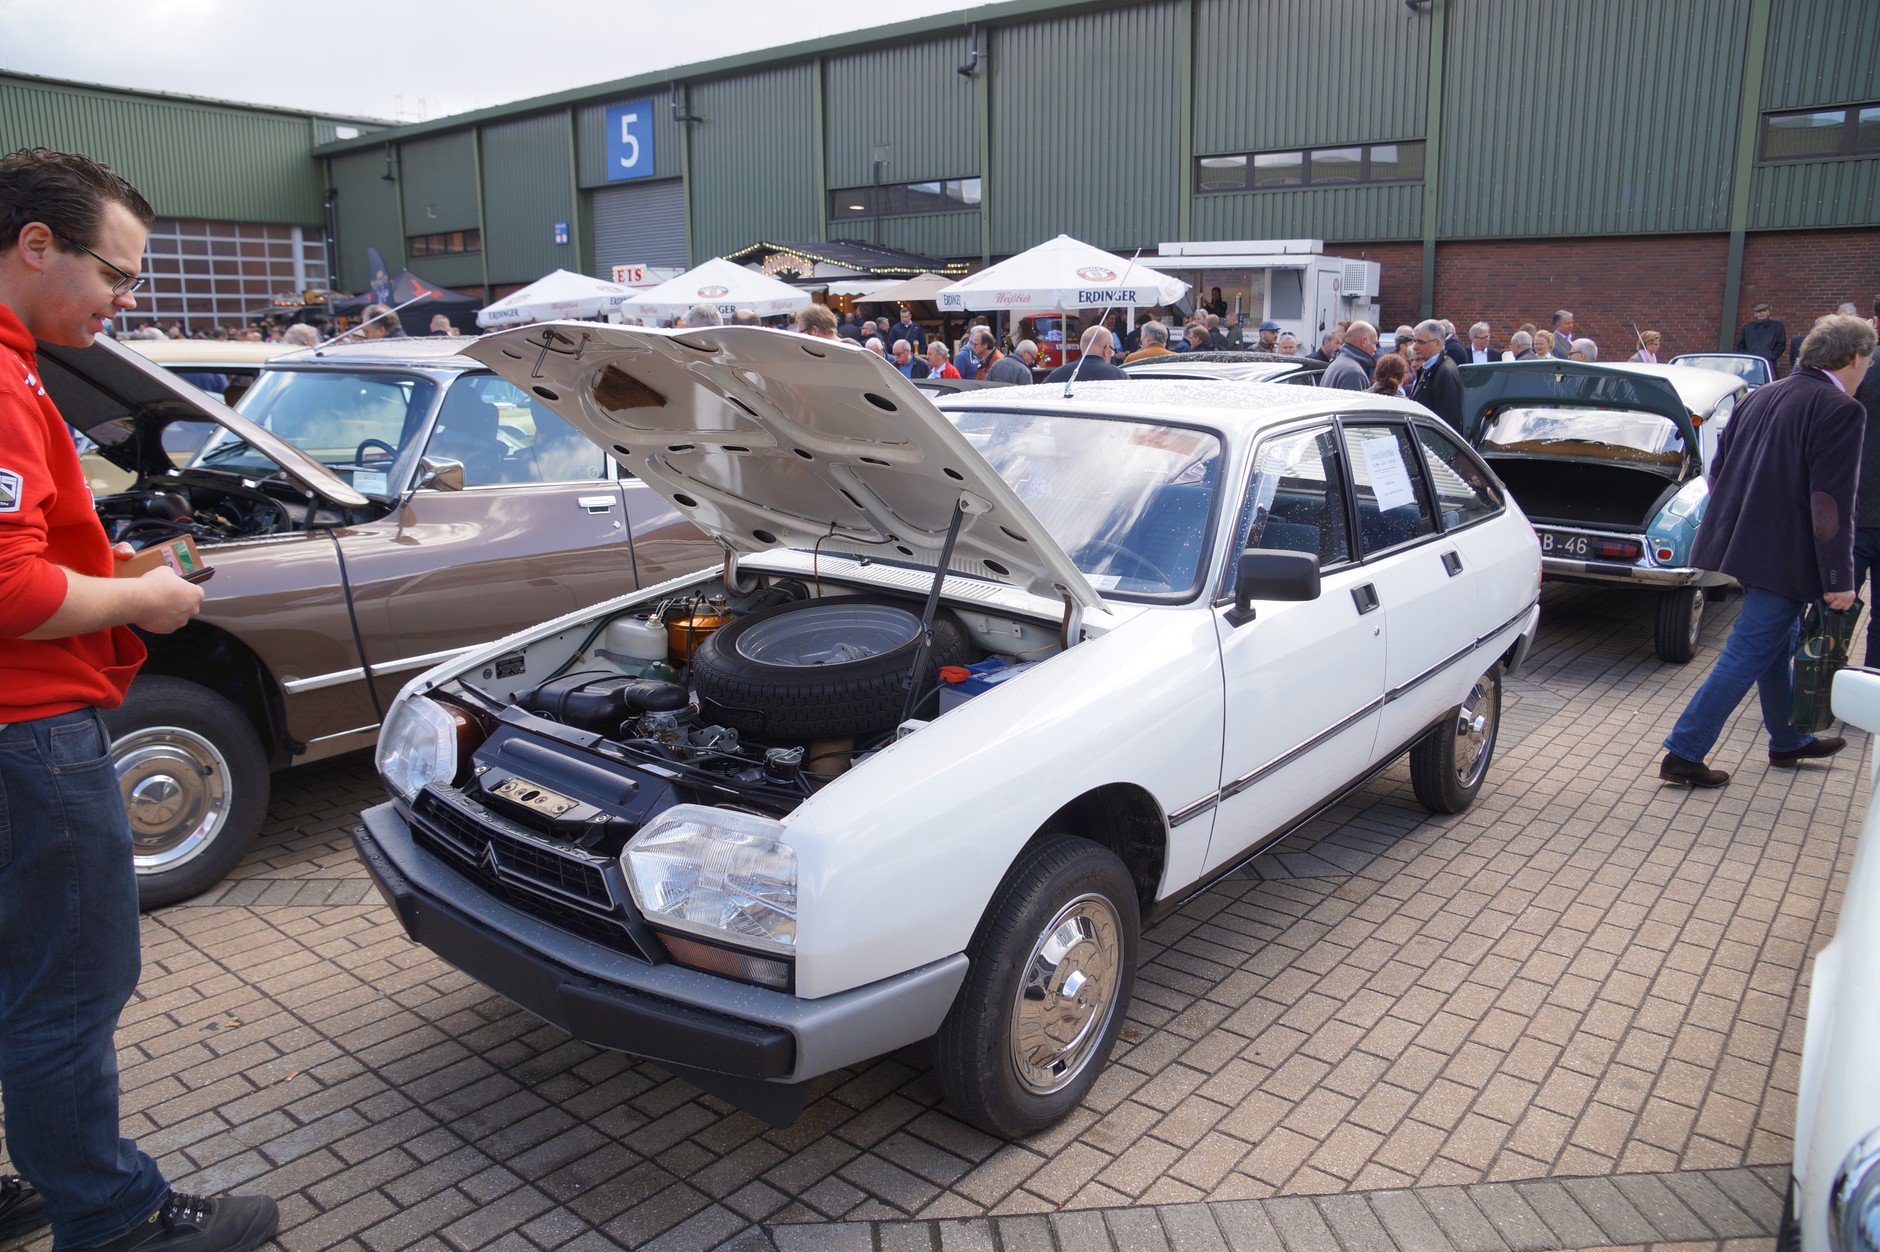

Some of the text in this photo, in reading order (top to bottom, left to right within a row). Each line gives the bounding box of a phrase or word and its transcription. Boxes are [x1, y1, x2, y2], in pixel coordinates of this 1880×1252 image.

[620, 113, 640, 168] 5
[617, 268, 642, 282] EIS
[994, 293, 1031, 305] Weißbier
[1079, 291, 1136, 304] ERDINGER
[488, 308, 519, 321] ERDINGER
[1537, 533, 1588, 555] B-46
